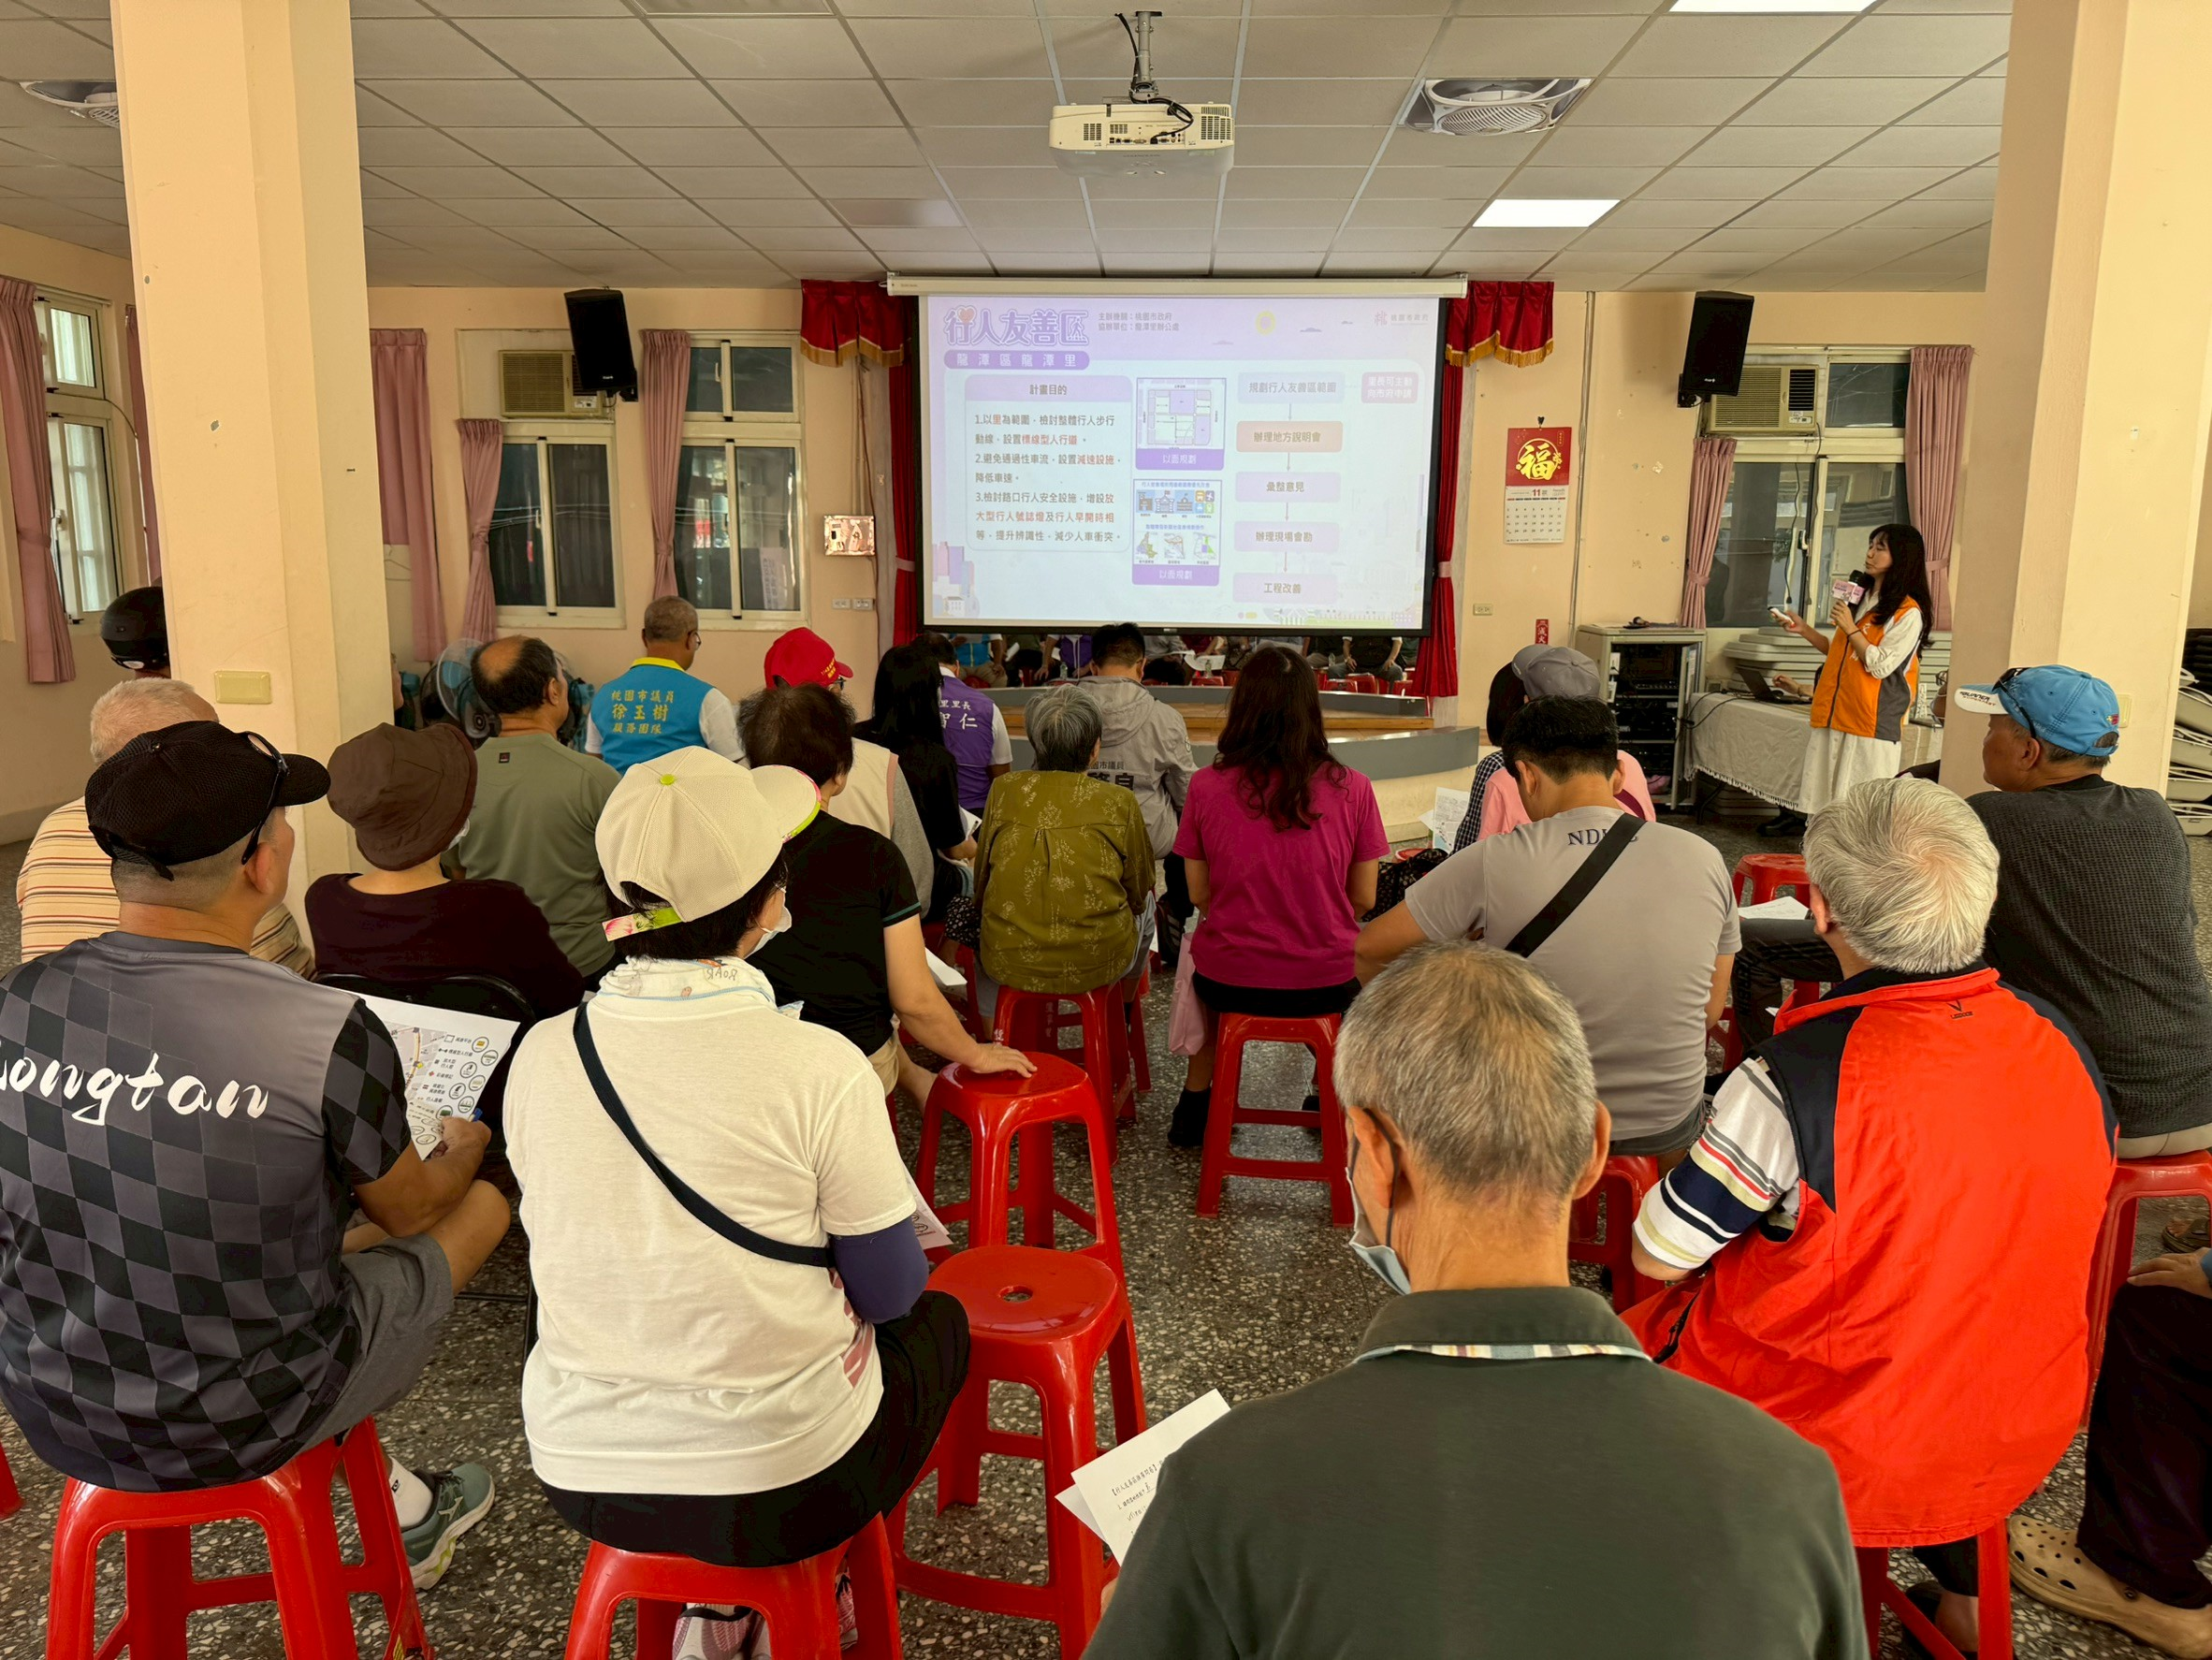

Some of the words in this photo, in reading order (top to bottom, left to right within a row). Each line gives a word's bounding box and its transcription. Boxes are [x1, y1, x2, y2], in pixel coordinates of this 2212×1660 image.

[1028, 384, 1068, 396] 計畫目的
[1519, 442, 1556, 481] 福
[1263, 583, 1302, 594] 工程改善
[612, 703, 669, 722] 徐玉樹
